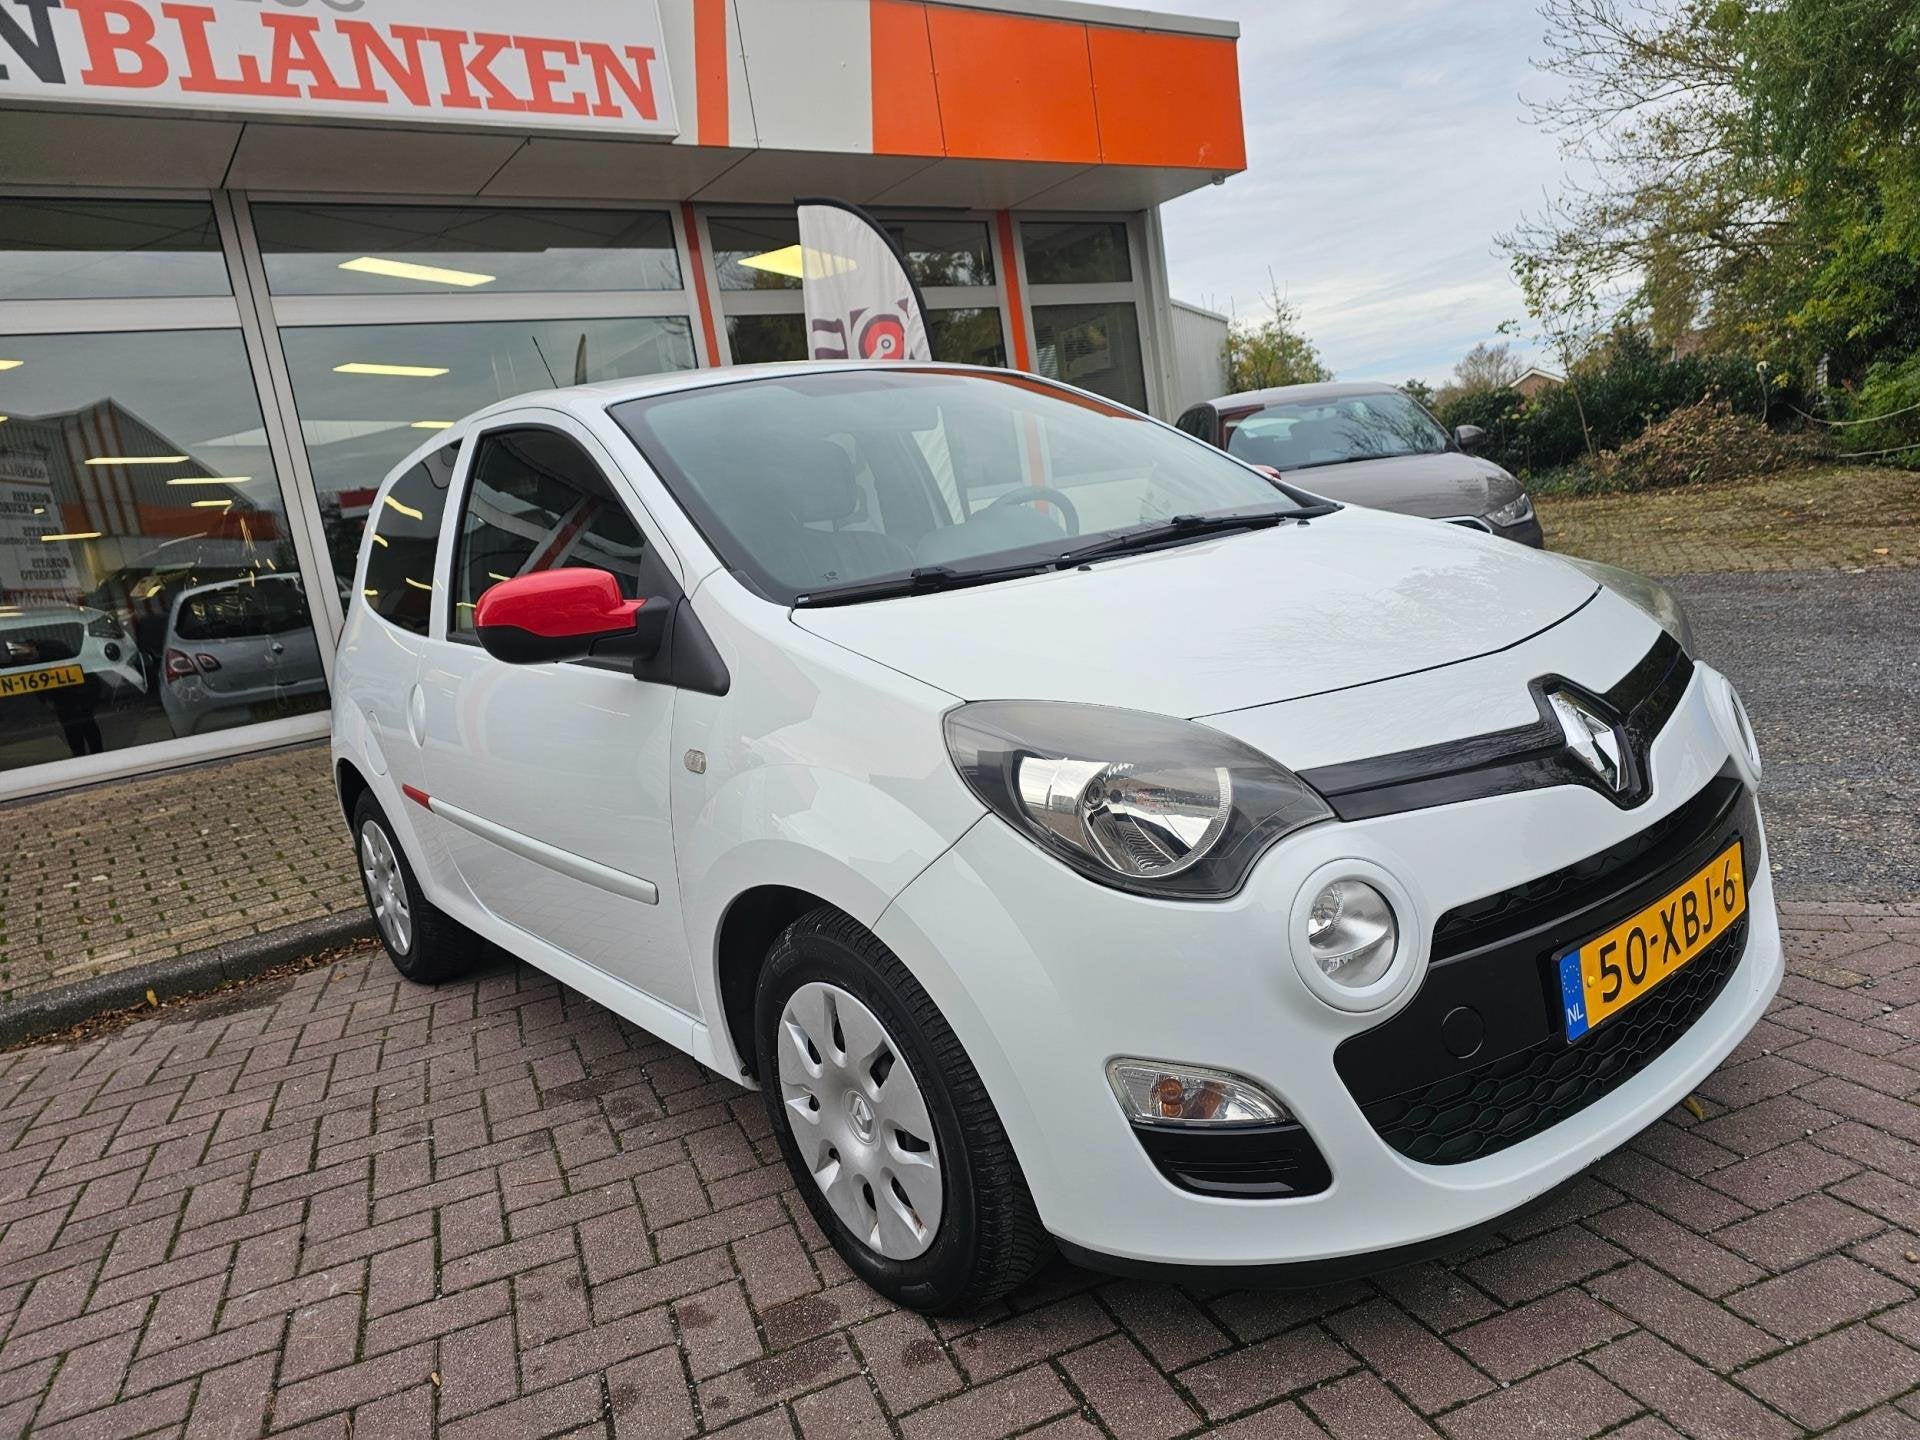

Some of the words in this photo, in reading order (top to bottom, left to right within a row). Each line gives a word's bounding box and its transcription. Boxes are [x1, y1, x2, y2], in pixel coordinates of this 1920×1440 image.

[1, 669, 77, 693] N-169-LL
[1599, 859, 1736, 1003] 50-XBJ-6
[1567, 1003, 1584, 1026] NL
